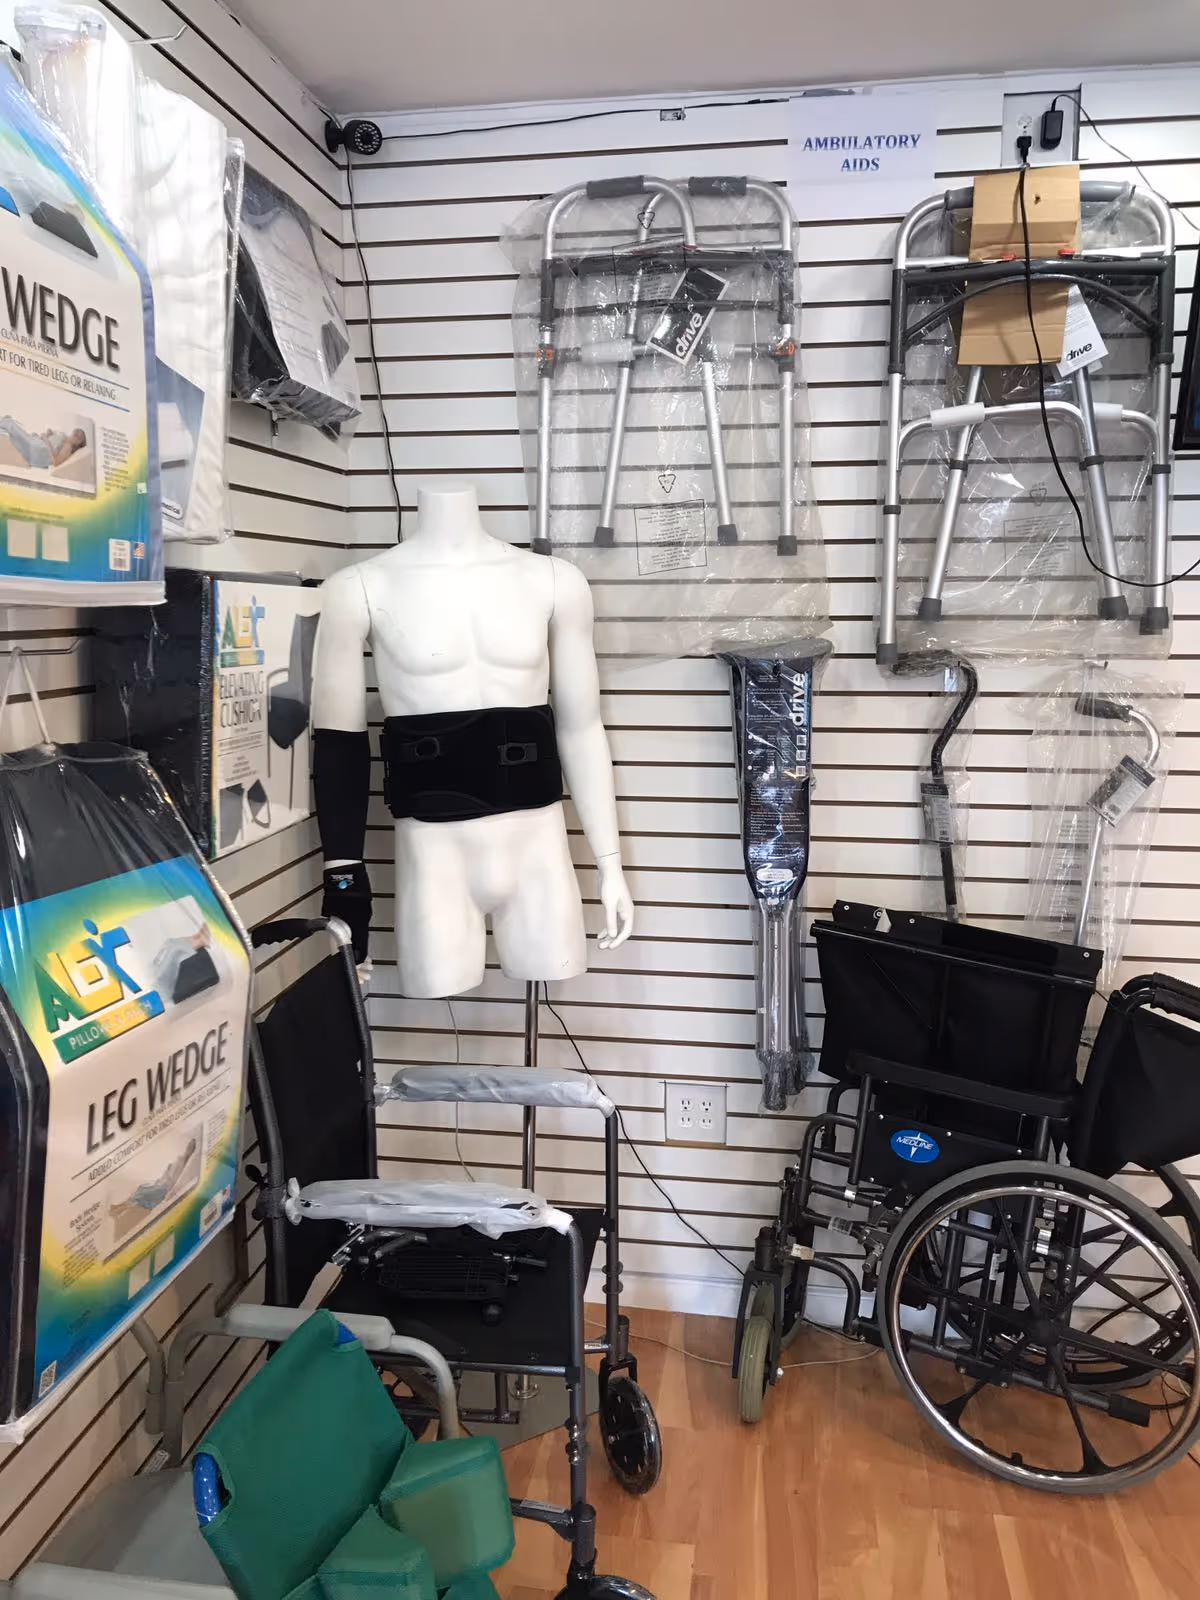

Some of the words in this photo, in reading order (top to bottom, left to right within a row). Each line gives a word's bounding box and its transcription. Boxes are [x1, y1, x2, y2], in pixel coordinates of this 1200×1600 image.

[802, 134, 921, 152] AMBULATORY
[840, 157, 880, 172] AIDS
[1, 266, 120, 371] WEDGE
[675, 312, 703, 357] drive
[1066, 343, 1093, 361] drive
[9, 351, 26, 370] FOR
[27, 358, 49, 377] TIRED
[51, 368, 69, 384] LEGS
[70, 375, 82, 389] OR
[83, 379, 116, 400] RELAXING
[789, 672, 805, 726] drive
[87, 1078, 137, 1154] LEG
[147, 1021, 229, 1112] WEDGE
[896, 1136, 934, 1150] MEDLINE
